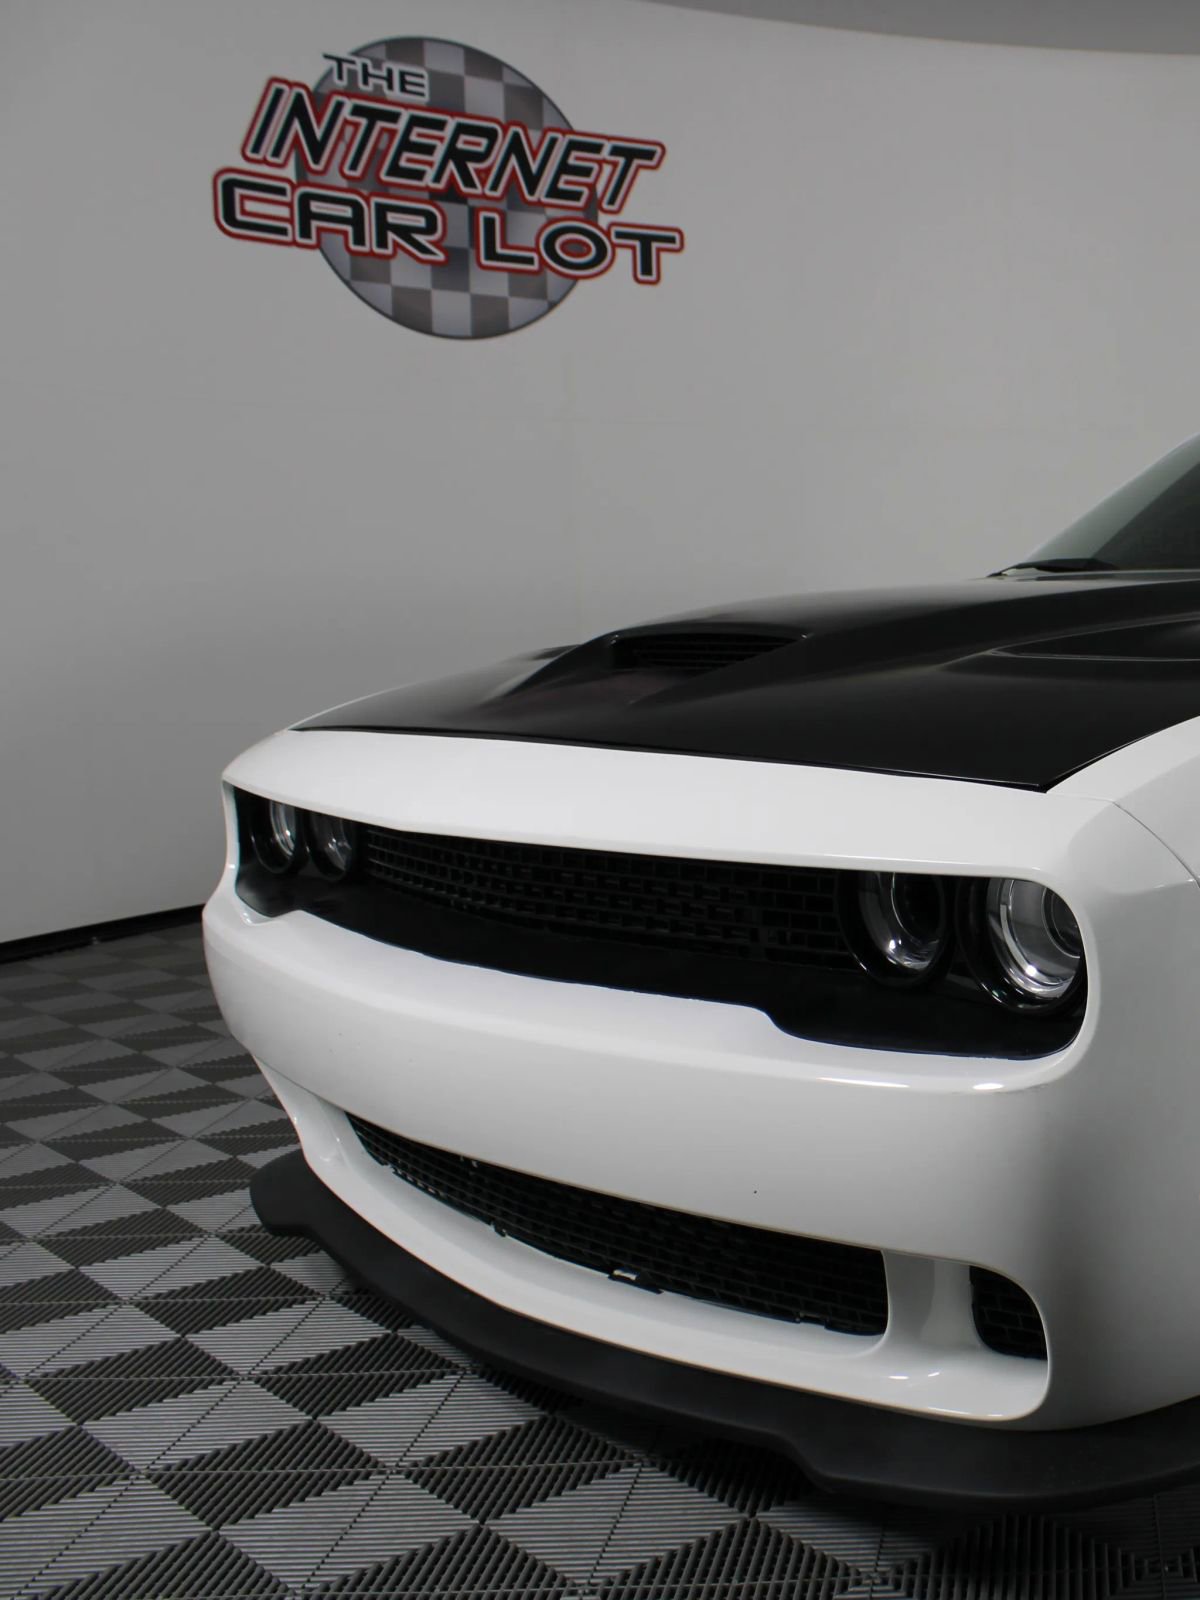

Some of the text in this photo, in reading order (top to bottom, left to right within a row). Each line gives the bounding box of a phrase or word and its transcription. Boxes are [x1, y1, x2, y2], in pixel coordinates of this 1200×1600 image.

[322, 52, 429, 101] THE
[244, 79, 663, 211] INTERNET
[216, 171, 682, 282] CAR LOT
